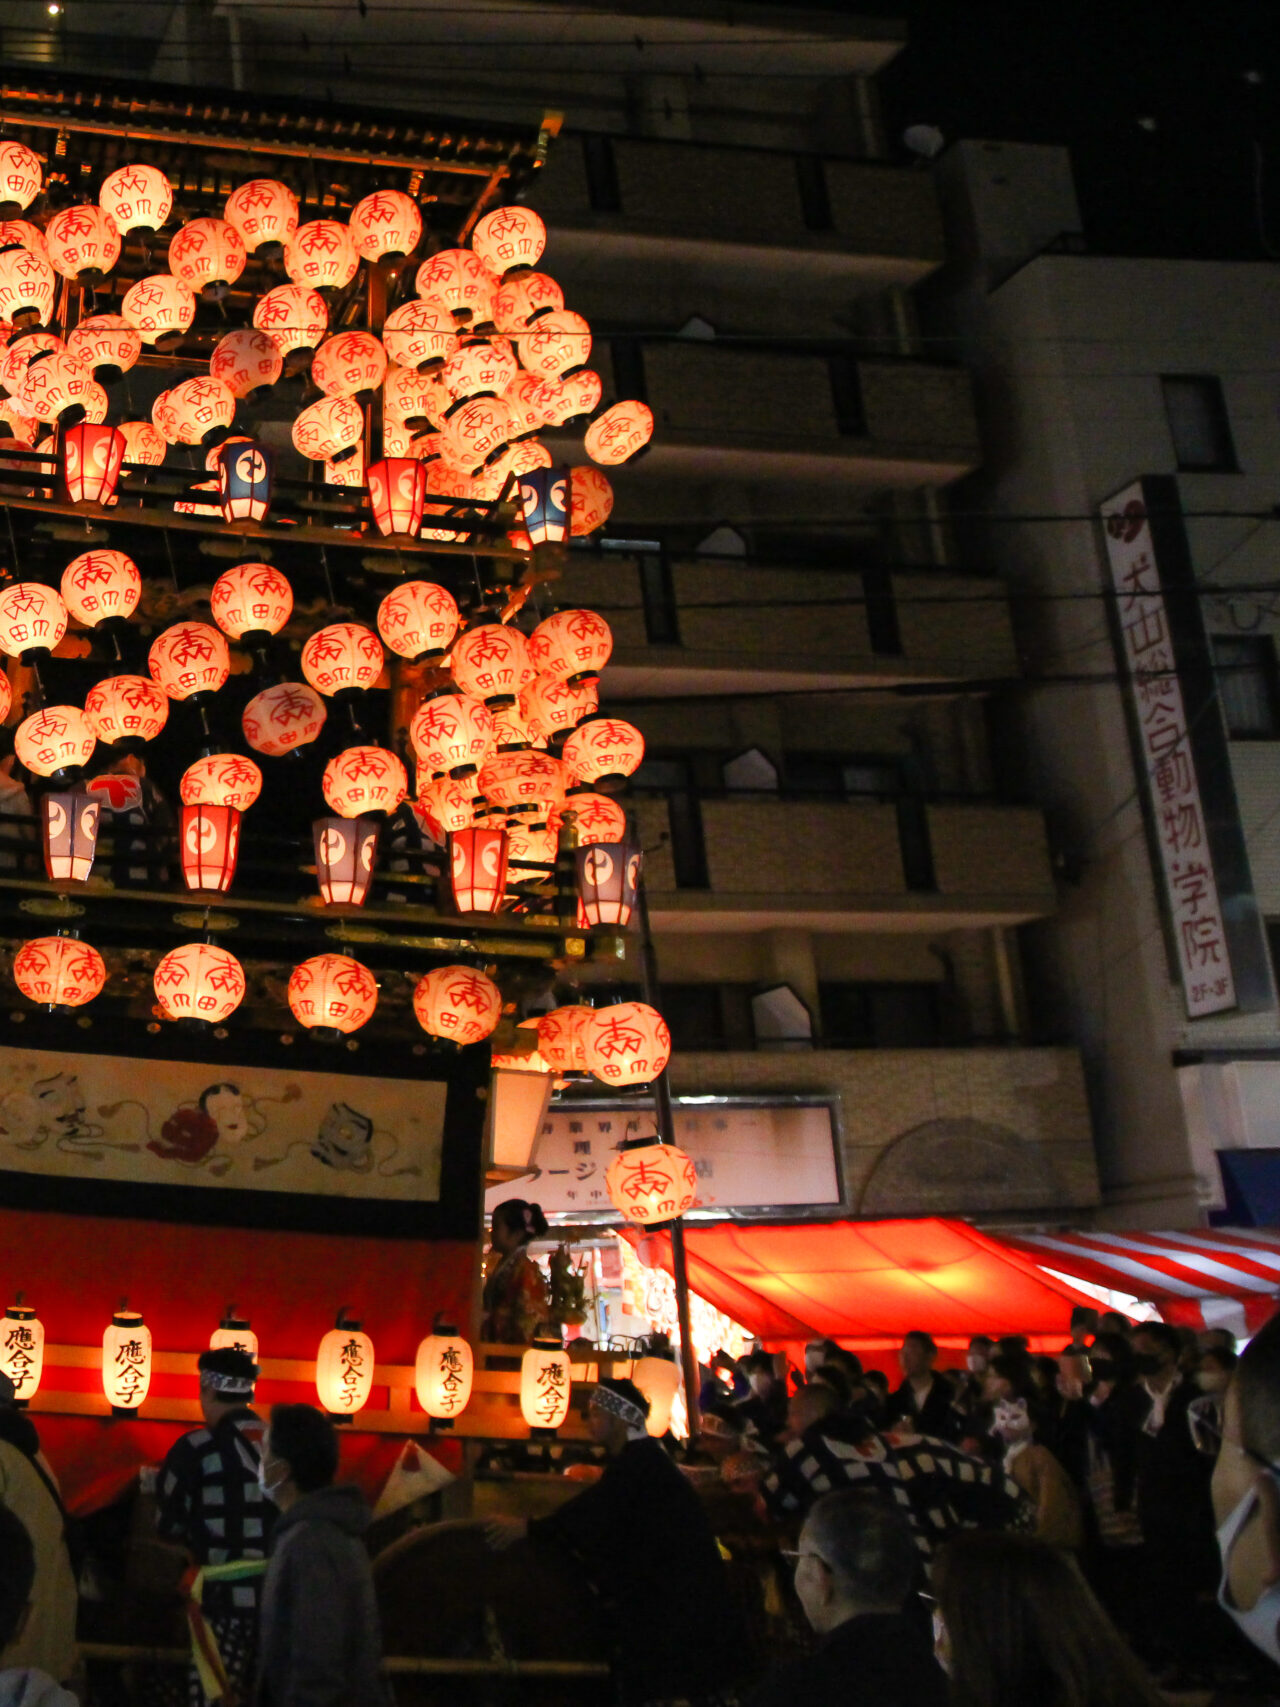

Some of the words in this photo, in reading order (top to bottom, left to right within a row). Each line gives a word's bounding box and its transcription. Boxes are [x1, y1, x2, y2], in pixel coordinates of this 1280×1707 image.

[1121, 556, 1222, 970] 犬山総合動物学院
[114, 1339, 147, 1405] 應合子
